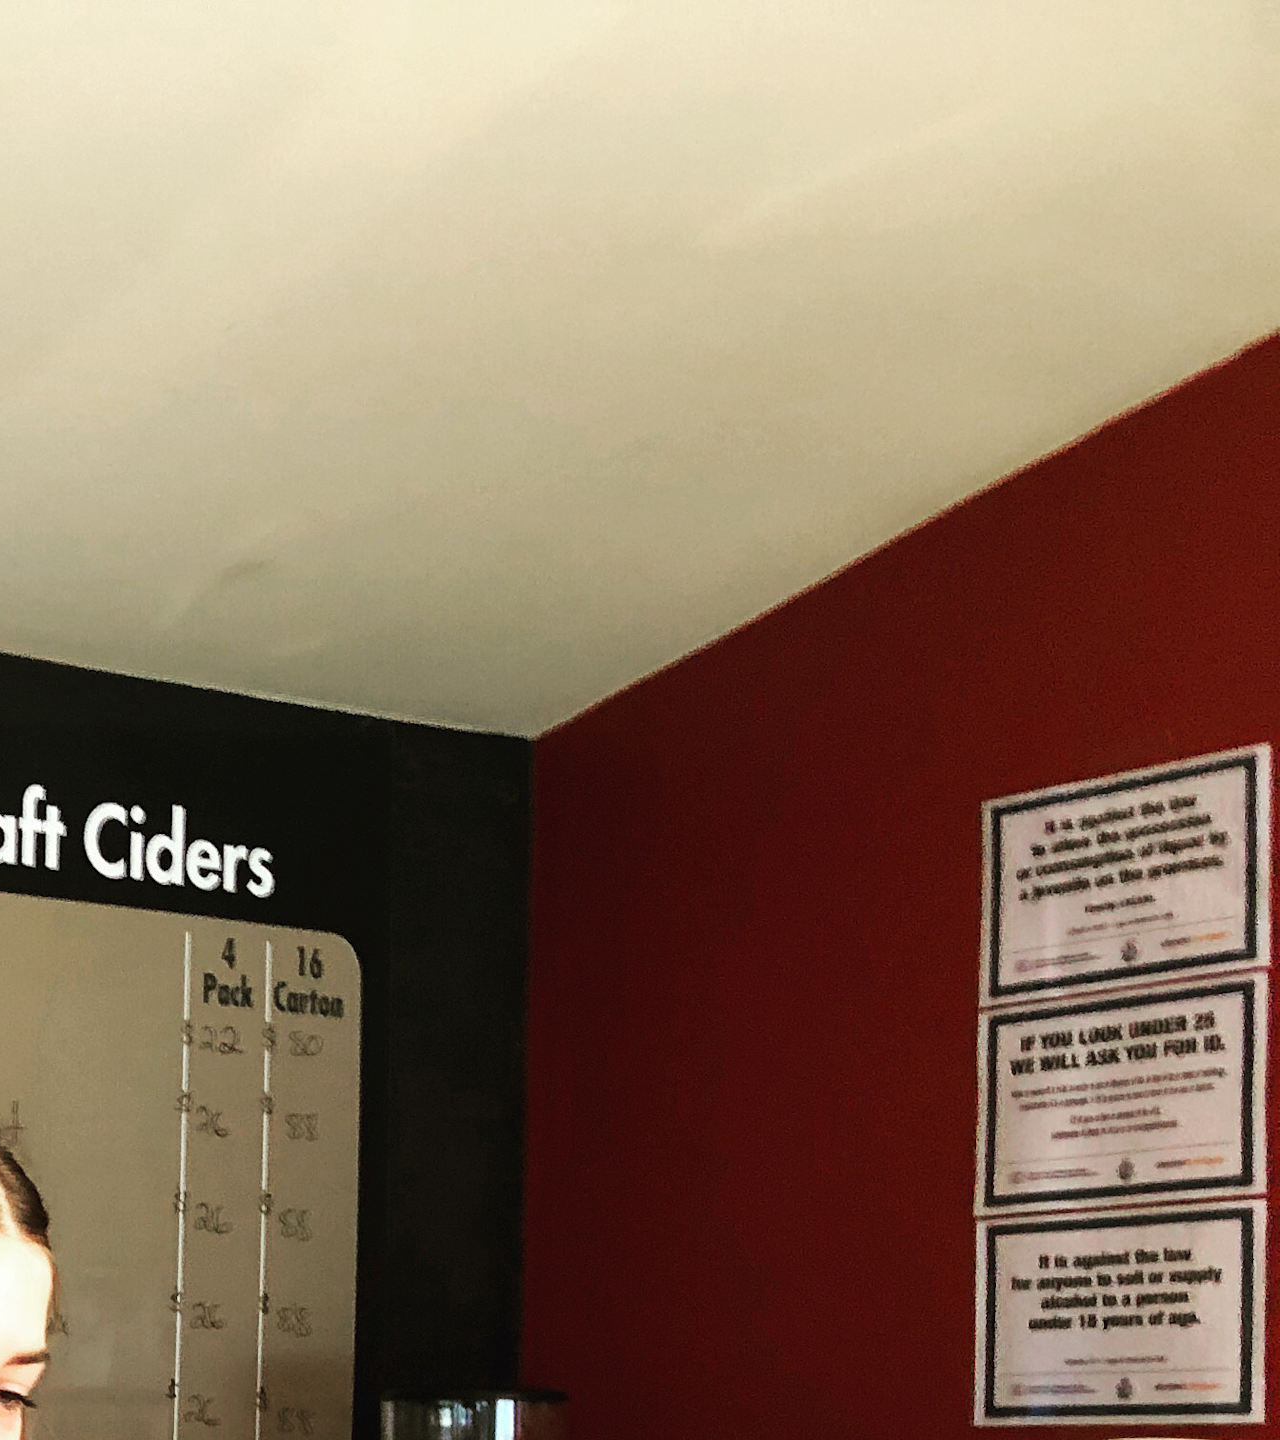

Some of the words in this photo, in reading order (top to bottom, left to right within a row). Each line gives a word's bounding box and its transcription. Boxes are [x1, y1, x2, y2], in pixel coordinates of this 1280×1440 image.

[83, 802, 276, 899] Ciders
[221, 936, 237, 970] 4
[296, 945, 323, 980] 16
[202, 972, 254, 1009] Pack
[273, 980, 344, 1019] Carton
[1020, 1034, 1036, 1053] IF
[1040, 1030, 1074, 1050] YOU
[1078, 1024, 1124, 1046] LOOK
[1128, 1014, 1188, 1039] UNDER
[1010, 1056, 1035, 1076] WE
[1040, 1052, 1080, 1072] WILL
[1085, 1046, 1121, 1067] ASK
[1125, 1041, 1159, 1061] YOU
[1163, 1037, 1198, 1056] FOR
[1039, 1253, 1049, 1269] It
[1072, 1250, 1130, 1271] against
[1134, 1247, 1160, 1264] the
[1163, 1247, 1192, 1263] law
[1011, 1276, 1032, 1291] for
[1036, 1276, 1093, 1294] anyone
[1040, 1295, 1097, 1311] alcohol
[1028, 1316, 1072, 1332] under
[1079, 1312, 1098, 1329] 18
[1102, 1313, 1144, 1331] years
[1147, 1310, 1165, 1326] of
